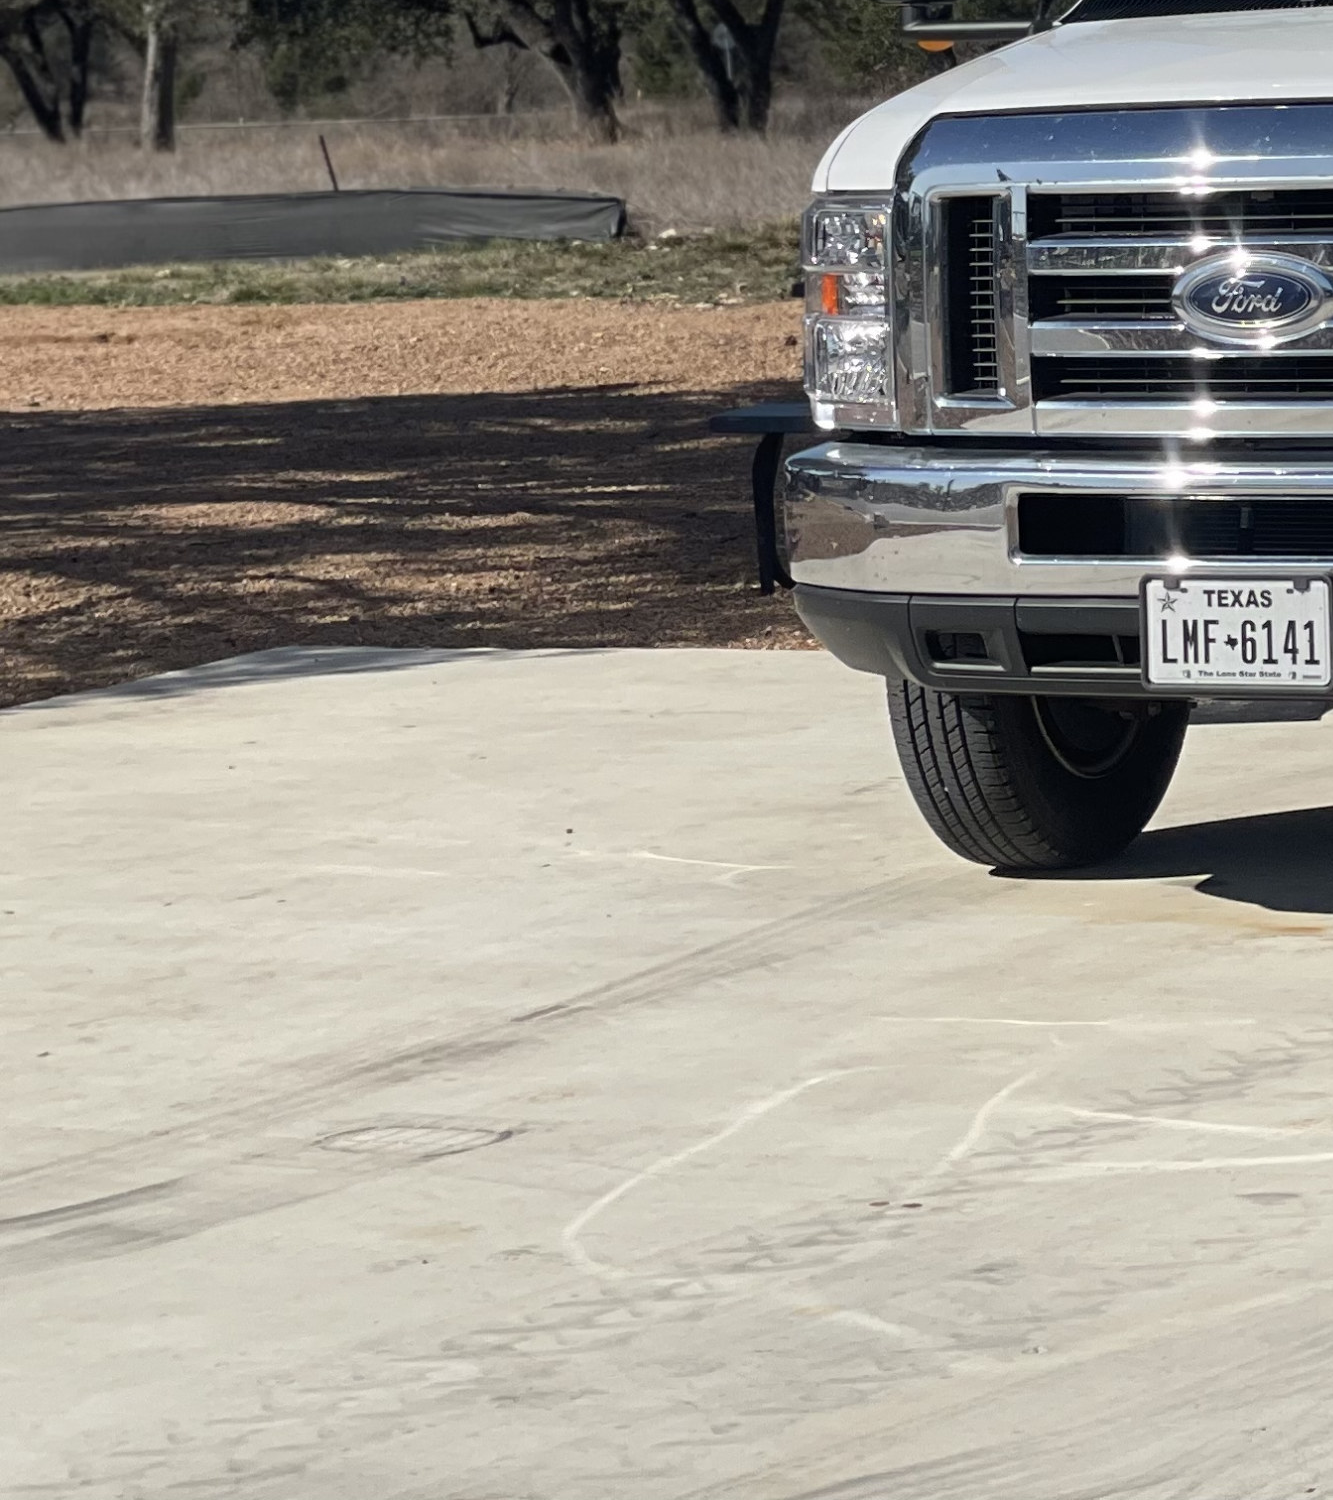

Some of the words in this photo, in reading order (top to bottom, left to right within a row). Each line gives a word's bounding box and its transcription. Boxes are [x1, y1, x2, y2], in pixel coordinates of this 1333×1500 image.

[1211, 279, 1284, 314] Ford
[1202, 589, 1273, 608] TEXAS
[1198, 670, 1214, 678] The
[1216, 670, 1237, 678] Lone
[1239, 670, 1257, 678] Star
[1259, 670, 1282, 678] State
